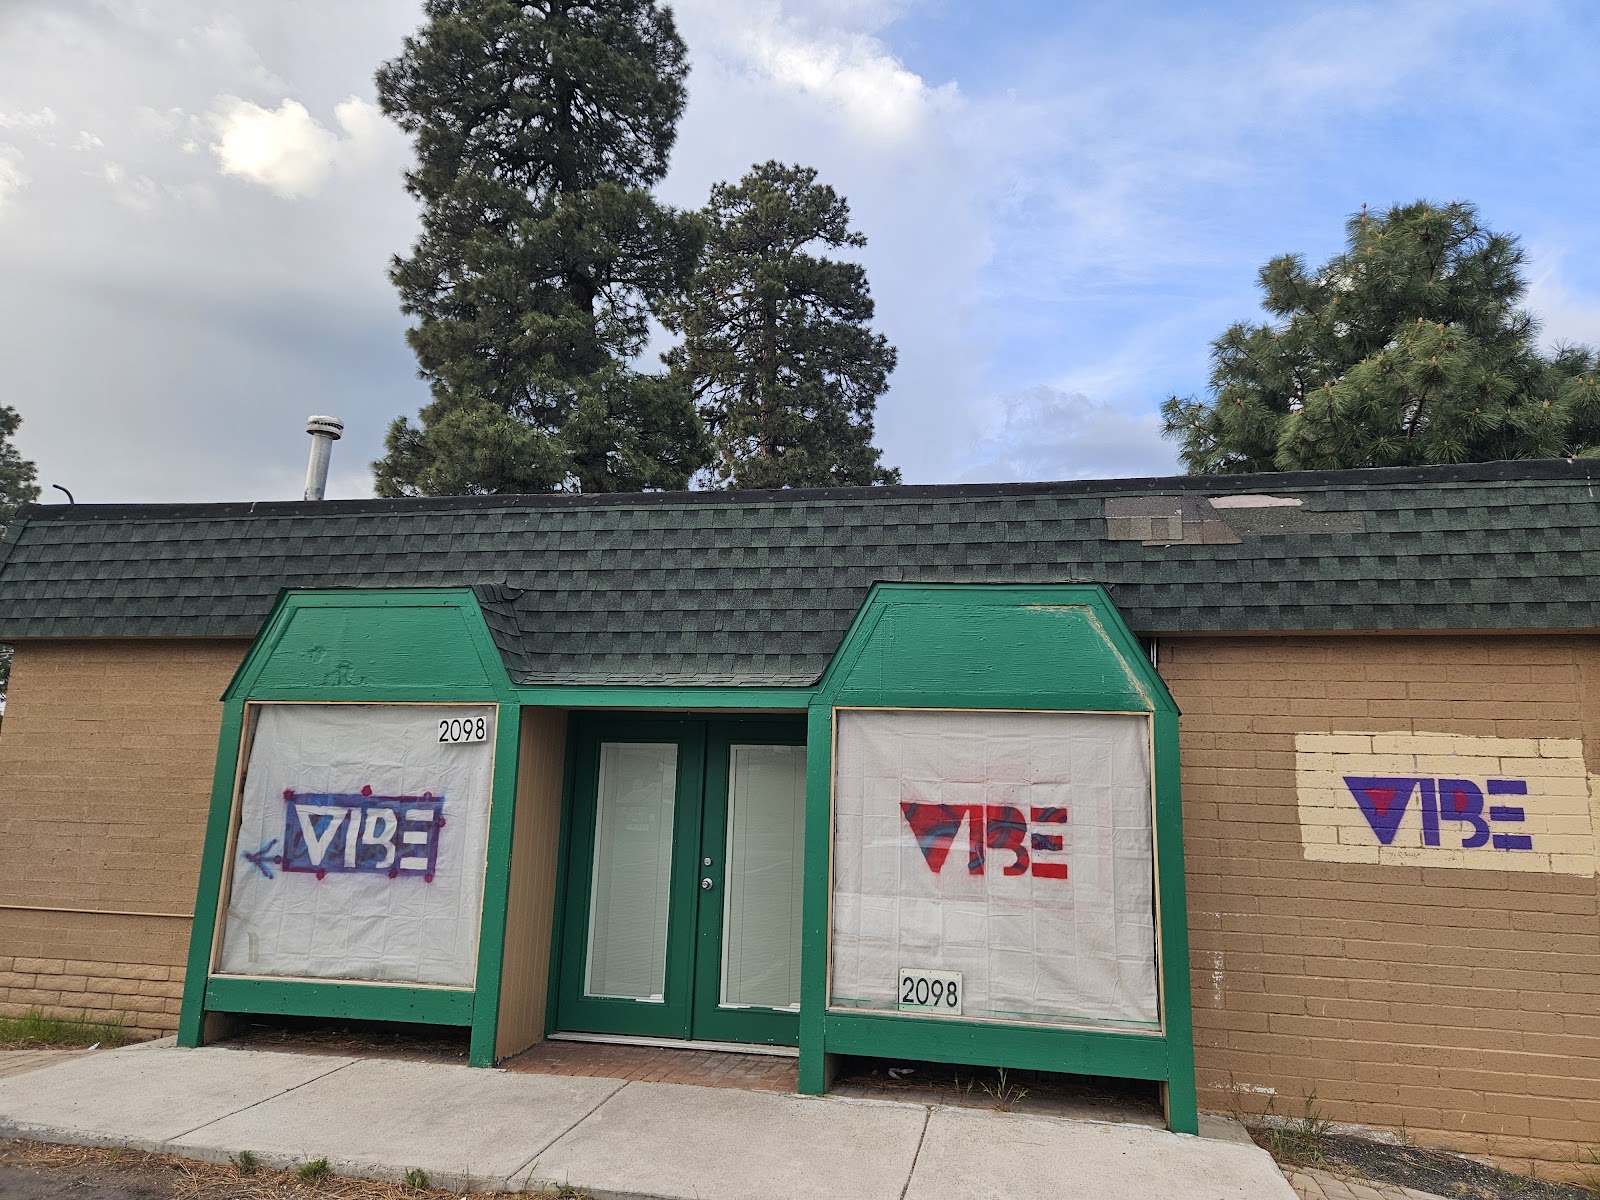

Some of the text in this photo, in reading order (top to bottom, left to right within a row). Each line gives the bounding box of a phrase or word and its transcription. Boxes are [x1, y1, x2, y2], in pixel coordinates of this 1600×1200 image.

[438, 718, 485, 742] 2098
[295, 804, 435, 870] VIBE
[900, 802, 1068, 879] VIBE
[1342, 776, 1533, 850] VIBE
[902, 976, 958, 1007] 2098
